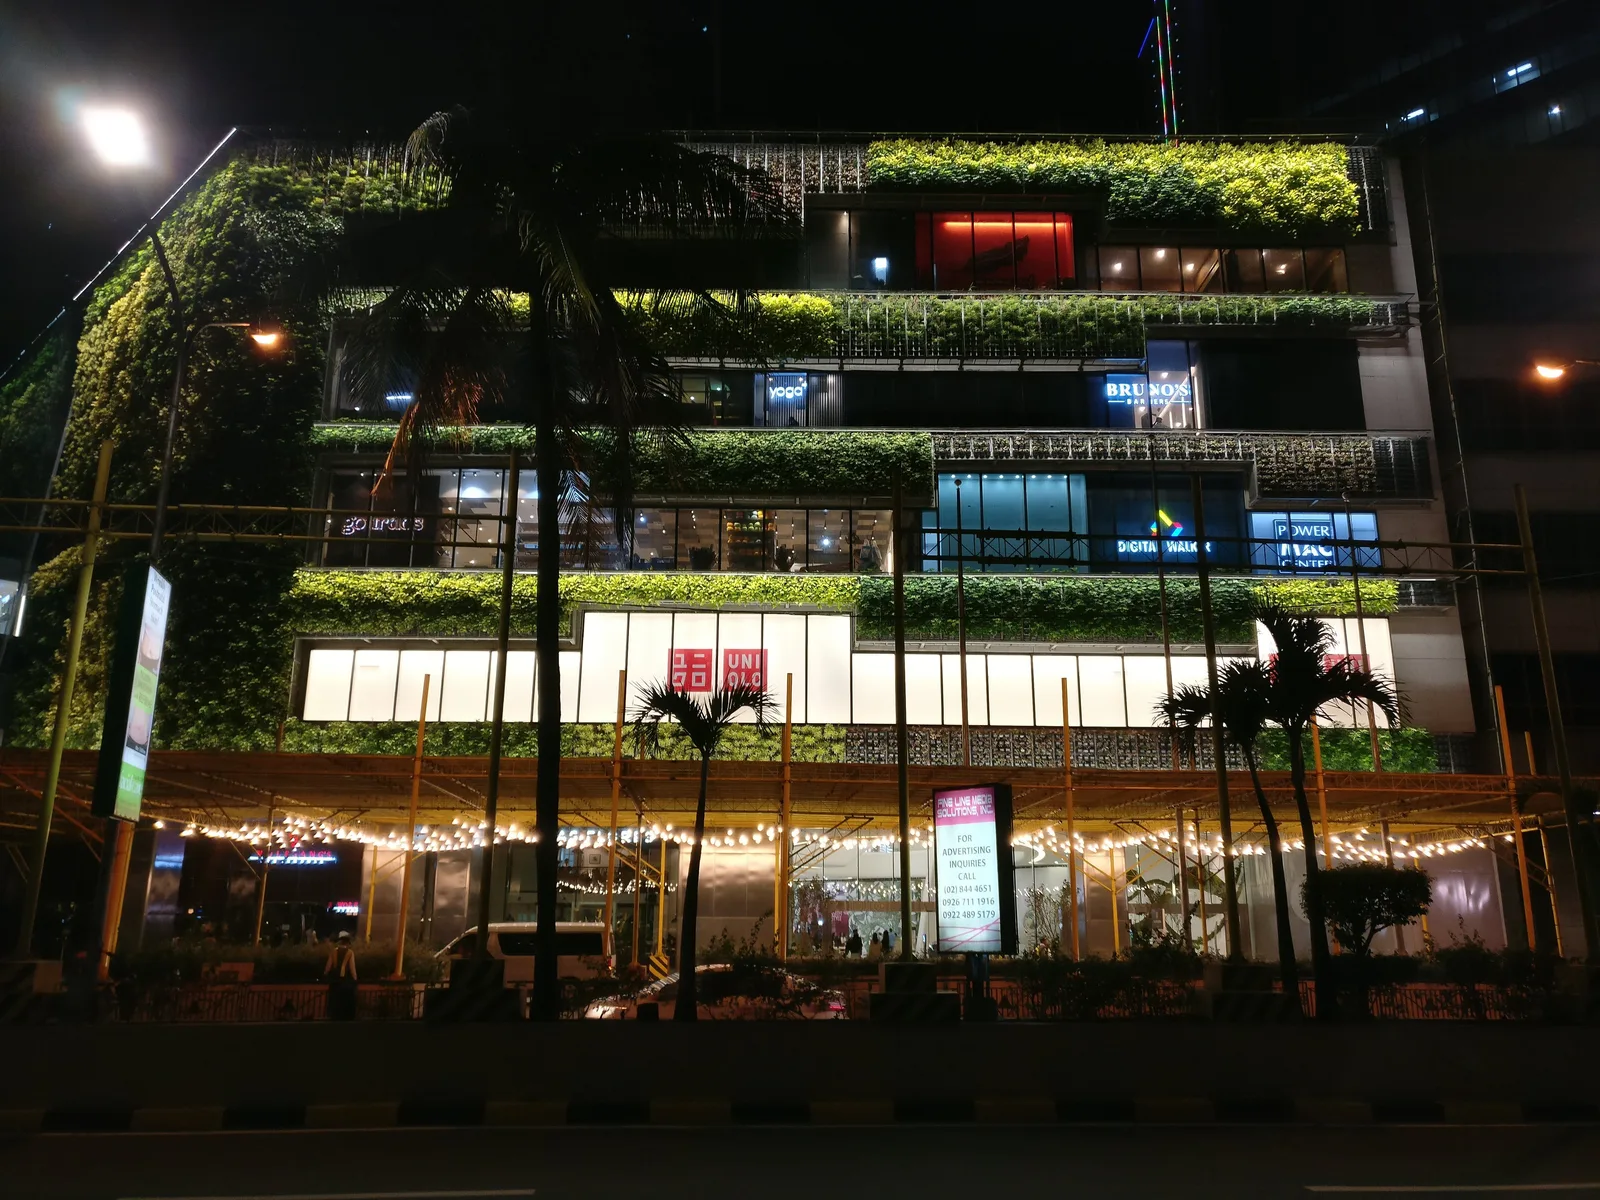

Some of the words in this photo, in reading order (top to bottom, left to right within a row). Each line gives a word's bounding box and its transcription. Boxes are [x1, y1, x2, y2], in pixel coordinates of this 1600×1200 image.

[1107, 383, 1188, 397] BRUNO'S
[1278, 525, 1330, 537] POWER
[1117, 541, 1158, 553] DIGITA
[1166, 541, 1211, 553] WALKR
[728, 653, 761, 669] UNI
[954, 795, 971, 806] LINE
[957, 834, 973, 843] FOR
[942, 845, 991, 856] ADVERTISING
[949, 859, 986, 869] INQUIRIES
[958, 872, 976, 880] CALL
[943, 885, 958, 894] (02)
[959, 885, 973, 893] 844
[974, 884, 992, 892] 4651
[942, 898, 960, 906] 0926
[962, 898, 975, 906] 711
[977, 897, 995, 905] 1916
[942, 911, 960, 919] 0922
[962, 910, 975, 919] 489
[977, 910, 996, 918] 5179
